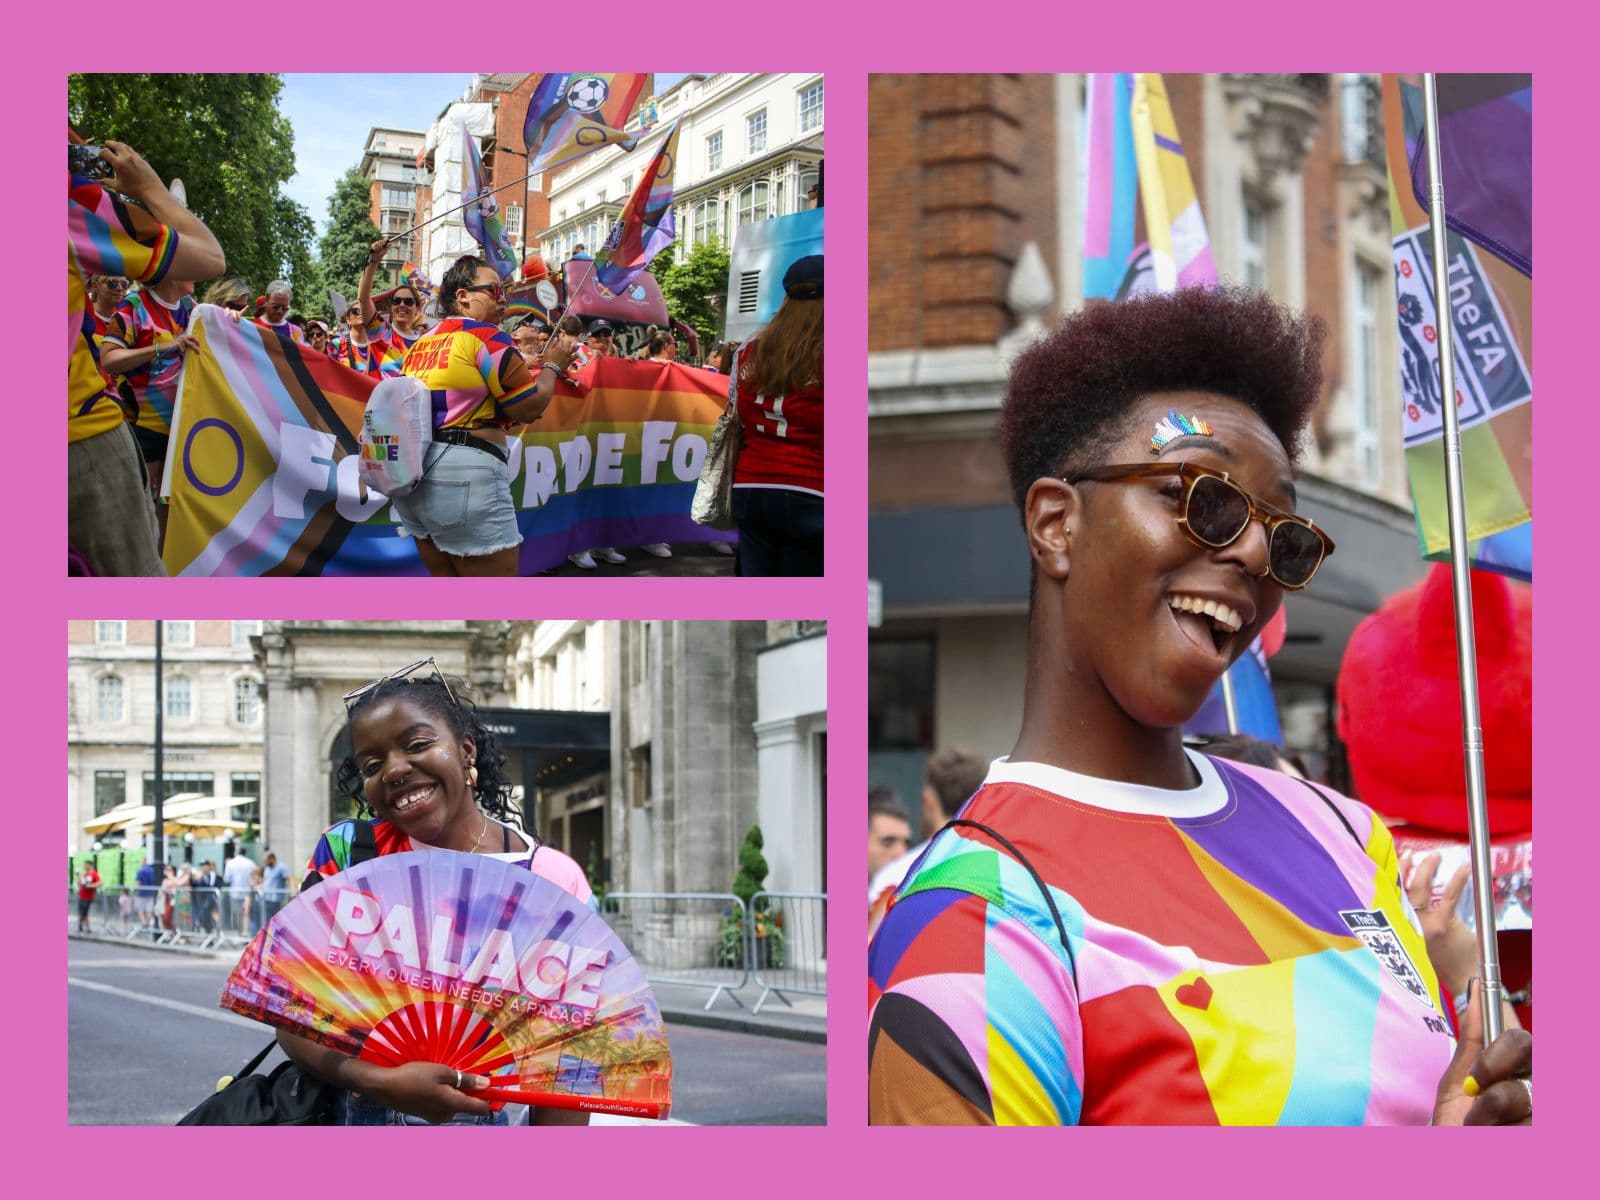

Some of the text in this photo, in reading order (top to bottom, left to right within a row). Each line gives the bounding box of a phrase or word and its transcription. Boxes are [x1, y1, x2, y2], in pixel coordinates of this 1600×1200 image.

[273, 422, 400, 523] FO
[358, 442, 399, 461] RIDE
[371, 434, 399, 444] WITH
[329, 889, 608, 1010] PALACE
[327, 951, 594, 1026] EVERY QUEEN NEEDS A PALACE
